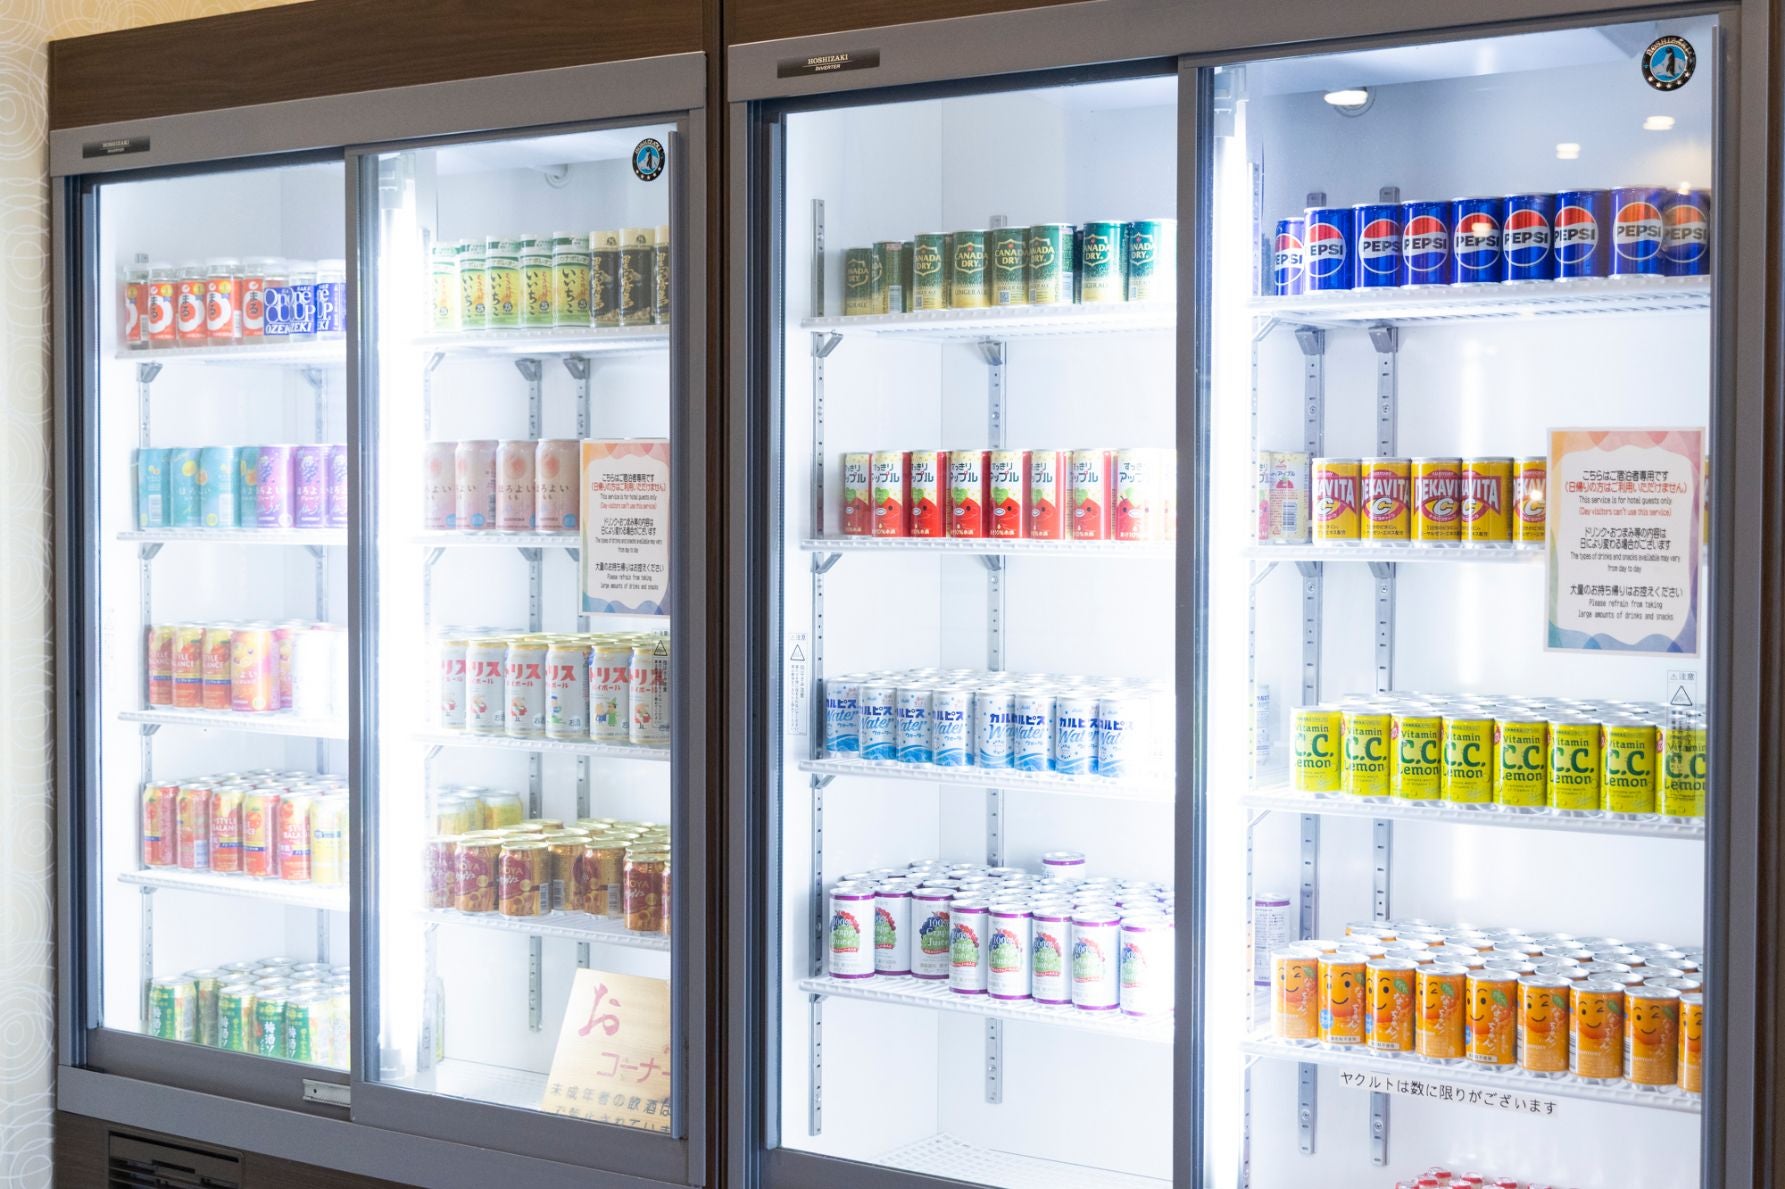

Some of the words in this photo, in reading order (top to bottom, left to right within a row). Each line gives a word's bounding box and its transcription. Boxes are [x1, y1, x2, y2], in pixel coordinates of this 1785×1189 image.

[808, 54, 848, 64] HOSHIZAKI
[1505, 231, 1548, 244] PEPSI
[1554, 229, 1595, 241] PEPSI
[1617, 225, 1661, 237] PEPSI
[1363, 239, 1400, 252] PEPS
[1404, 238, 1447, 250] PEPSI
[1456, 235, 1500, 248] PEPSI
[1310, 244, 1343, 256] EPSI
[1275, 254, 1302, 266] EPSI
[264, 288, 289, 307] On
[562, 267, 576, 314] いいちこ
[266, 304, 290, 323] CU
[294, 302, 315, 322] UP
[1583, 470, 1669, 482] こちらはご宿泊者専用です
[1318, 478, 1355, 509] AVITA
[1361, 478, 1409, 509] EKAVITA
[1415, 479, 1460, 511] DEKAVI
[1462, 479, 1499, 510] AVITA
[1612, 496, 1616, 504] is
[1618, 496, 1626, 504] for
[1642, 497, 1659, 505] guests
[1661, 497, 1672, 505] only
[1570, 584, 1683, 598] 大量のお持ち帰りはお控えください
[1589, 599, 1606, 607] Please
[1608, 600, 1628, 608] refrain
[1579, 610, 1592, 618] large
[1617, 611, 1622, 619] of
[472, 661, 501, 677] リス
[547, 664, 577, 681] リス
[1401, 731, 1437, 739] Vitamin
[1503, 735, 1540, 744] Vitamin
[1346, 736, 1387, 761] C.C.
[1401, 739, 1441, 764] C.C.
[1444, 742, 1486, 768] C.C.
[1297, 759, 1331, 769] emon
[1503, 744, 1544, 770] C.C.
[1551, 747, 1594, 773] C.C.
[1605, 749, 1650, 776] C.C.
[1401, 765, 1440, 775] emon
[1503, 771, 1543, 781] emon
[1549, 771, 1592, 785] Lemon
[1604, 774, 1648, 787] Lemon
[578, 983, 621, 1036] お
[1339, 1071, 1557, 1116] ヤクルトは数に限りがございます
